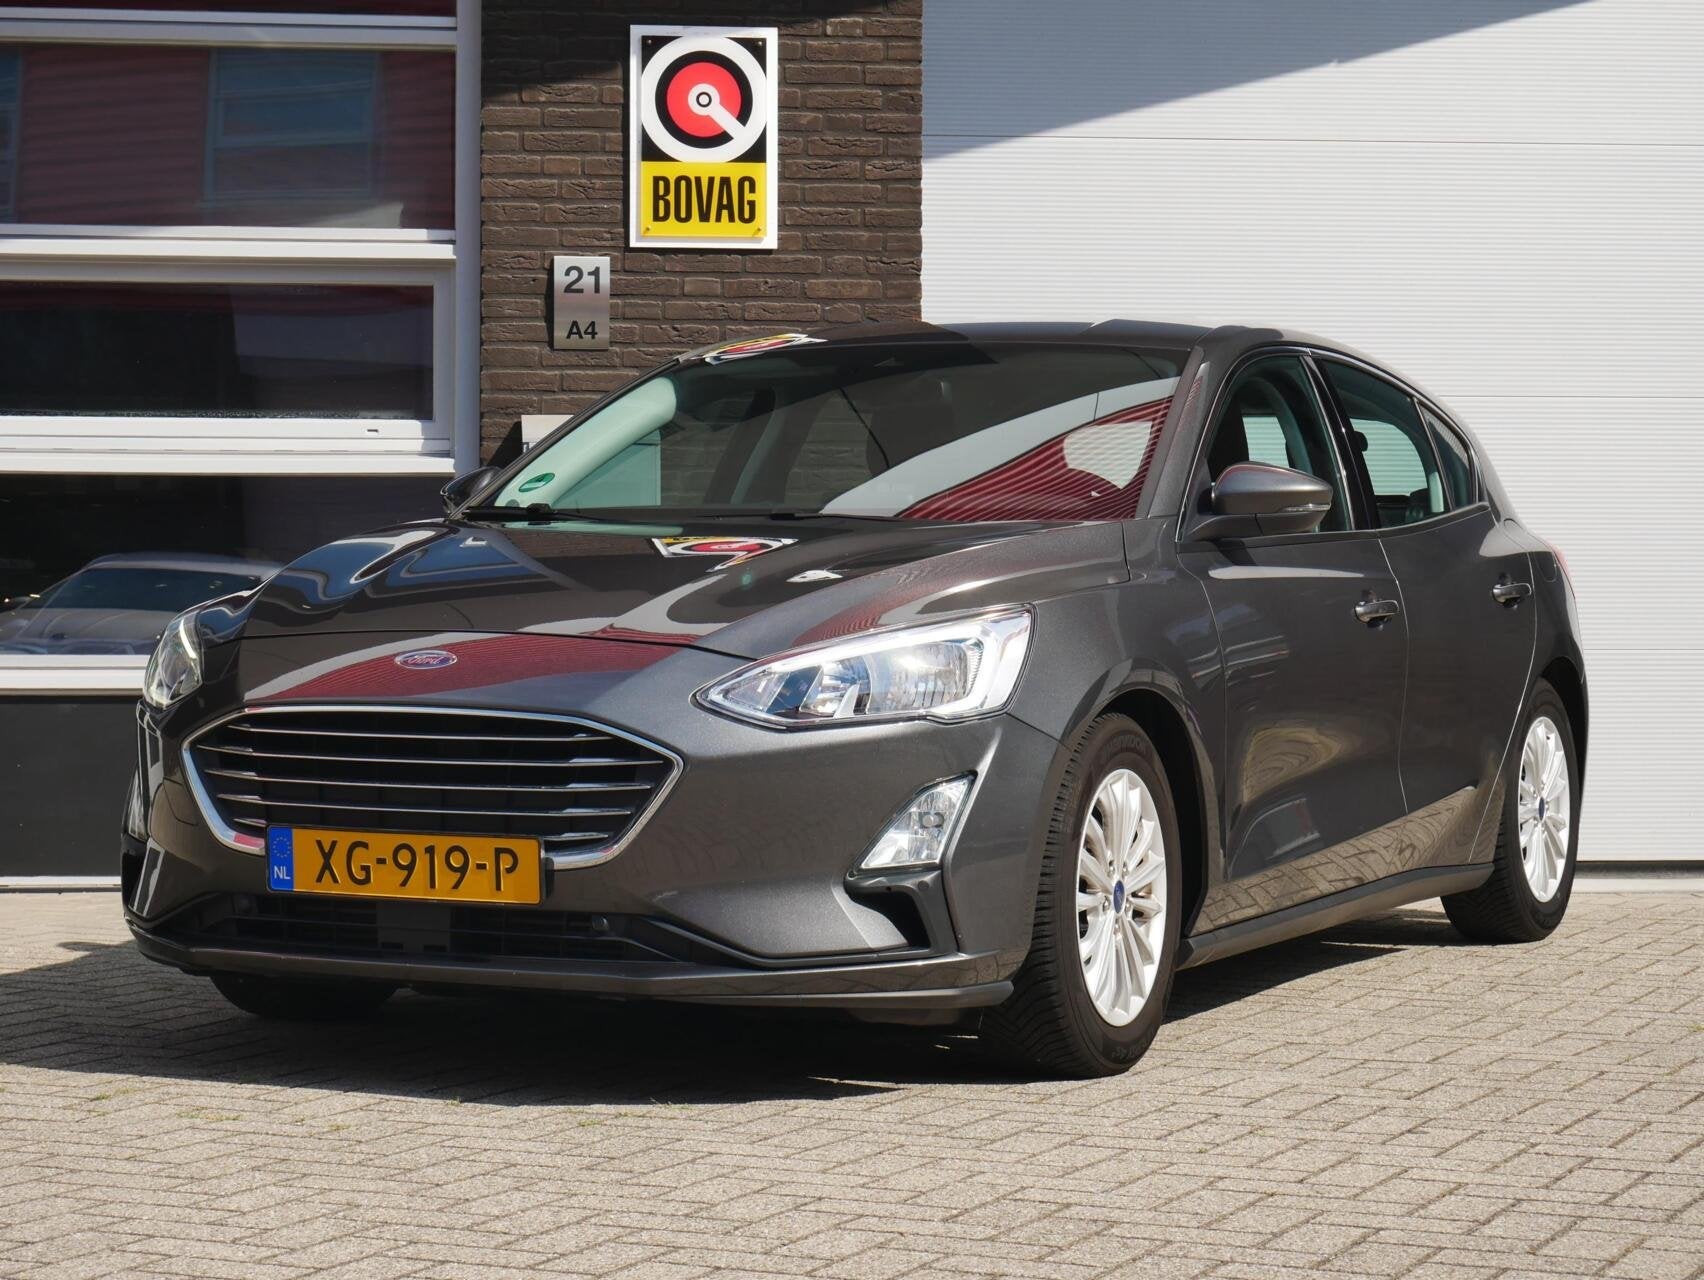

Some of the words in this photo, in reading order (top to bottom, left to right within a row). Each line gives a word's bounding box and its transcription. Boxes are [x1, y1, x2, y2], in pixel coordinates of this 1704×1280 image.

[652, 175, 756, 224] BOVAG
[563, 265, 600, 294] 21
[566, 320, 598, 340] A4
[273, 865, 291, 880] NL
[315, 839, 519, 891] XG-919-P
